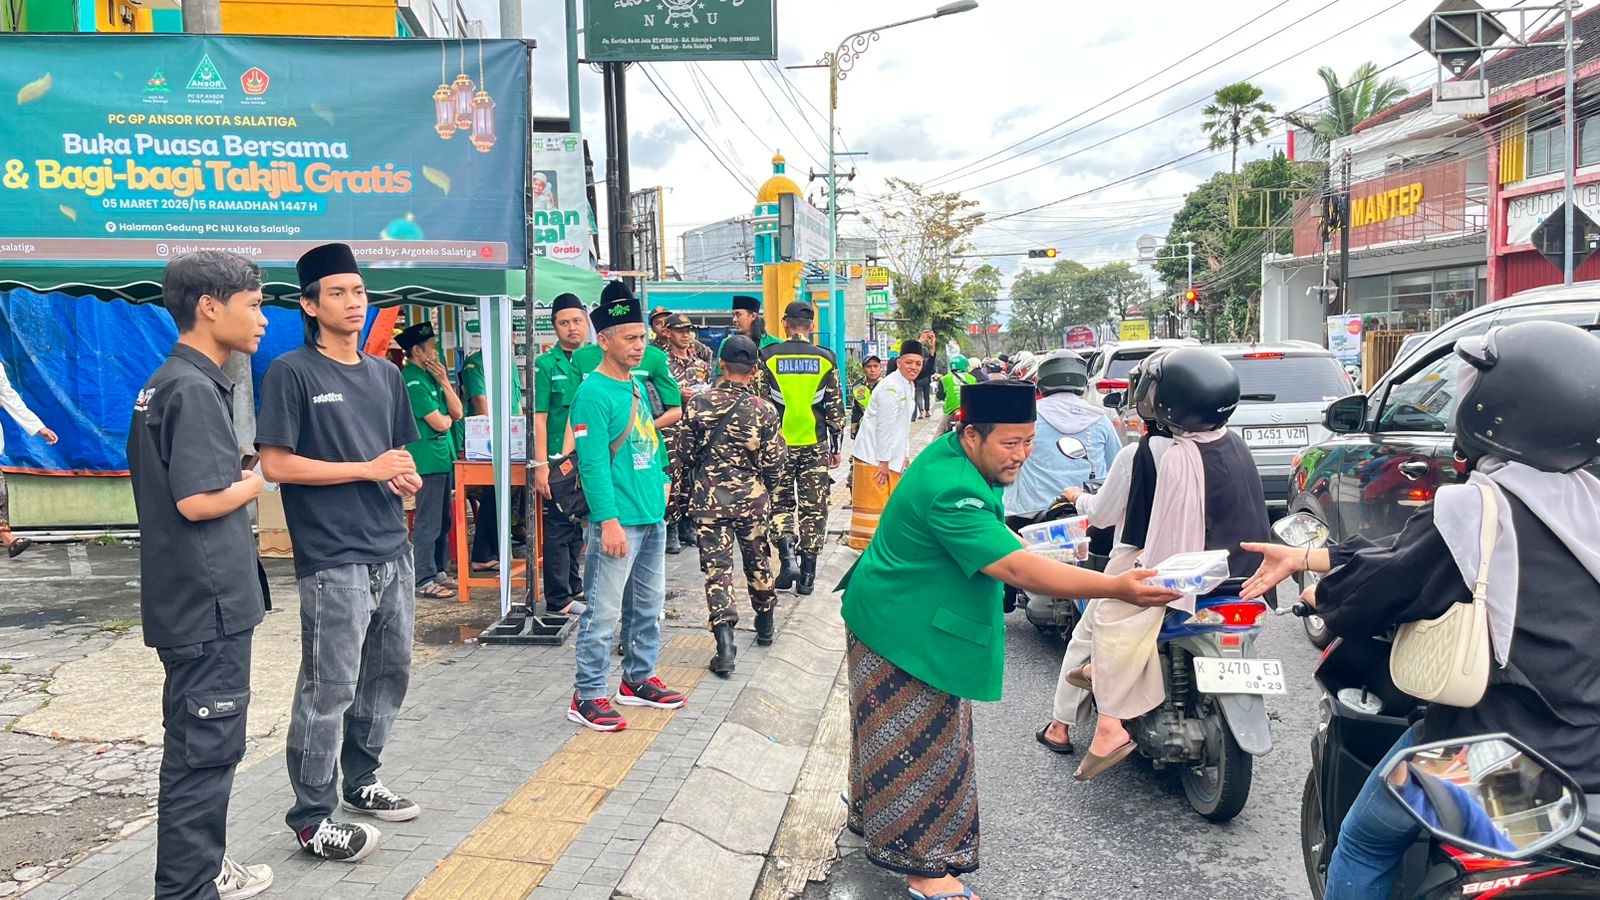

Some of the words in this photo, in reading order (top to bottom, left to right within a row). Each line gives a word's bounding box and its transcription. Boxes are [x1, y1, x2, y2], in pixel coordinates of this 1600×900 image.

[644, 14, 655, 26] N
[706, 12, 718, 24] U
[108, 114, 125, 124] PC
[128, 114, 146, 124] GP
[148, 114, 192, 125] ANSOR
[195, 115, 231, 126] KOTA
[234, 116, 297, 127] SALATIGA
[62, 132, 132, 155] Buka
[134, 133, 219, 156] Puasa
[222, 134, 348, 158] Bersama
[2, 159, 29, 189] &
[35, 158, 205, 197] Bagi-bagi
[205, 160, 302, 198] Takjil
[304, 162, 412, 193] Gratis
[102, 198, 118, 208] 05
[120, 199, 158, 209] MARET
[161, 197, 207, 212] 2026/15
[209, 200, 278, 211] RAMADHAN
[280, 201, 307, 211] 1447
[309, 202, 318, 211] H
[1352, 182, 1424, 228] MANTEP
[120, 223, 164, 232] Halaman
[166, 224, 204, 234] Gedung
[206, 224, 219, 232] PC
[221, 224, 234, 232] NU
[236, 225, 259, 233] Kota
[261, 225, 300, 235] Salatiga
[385, 246, 399, 257] by:
[401, 247, 439, 257] Argotelo
[441, 248, 476, 258] Salatiga
[553, 246, 580, 254] Gratis
[778, 360, 818, 372] BALANTAS
[1246, 431, 1252, 440] D
[1257, 430, 1281, 440] 1451
[1287, 428, 1306, 439] VZM
[1197, 661, 1206, 673] K
[1218, 662, 1250, 674] 3470
[1263, 663, 1280, 675] EJ
